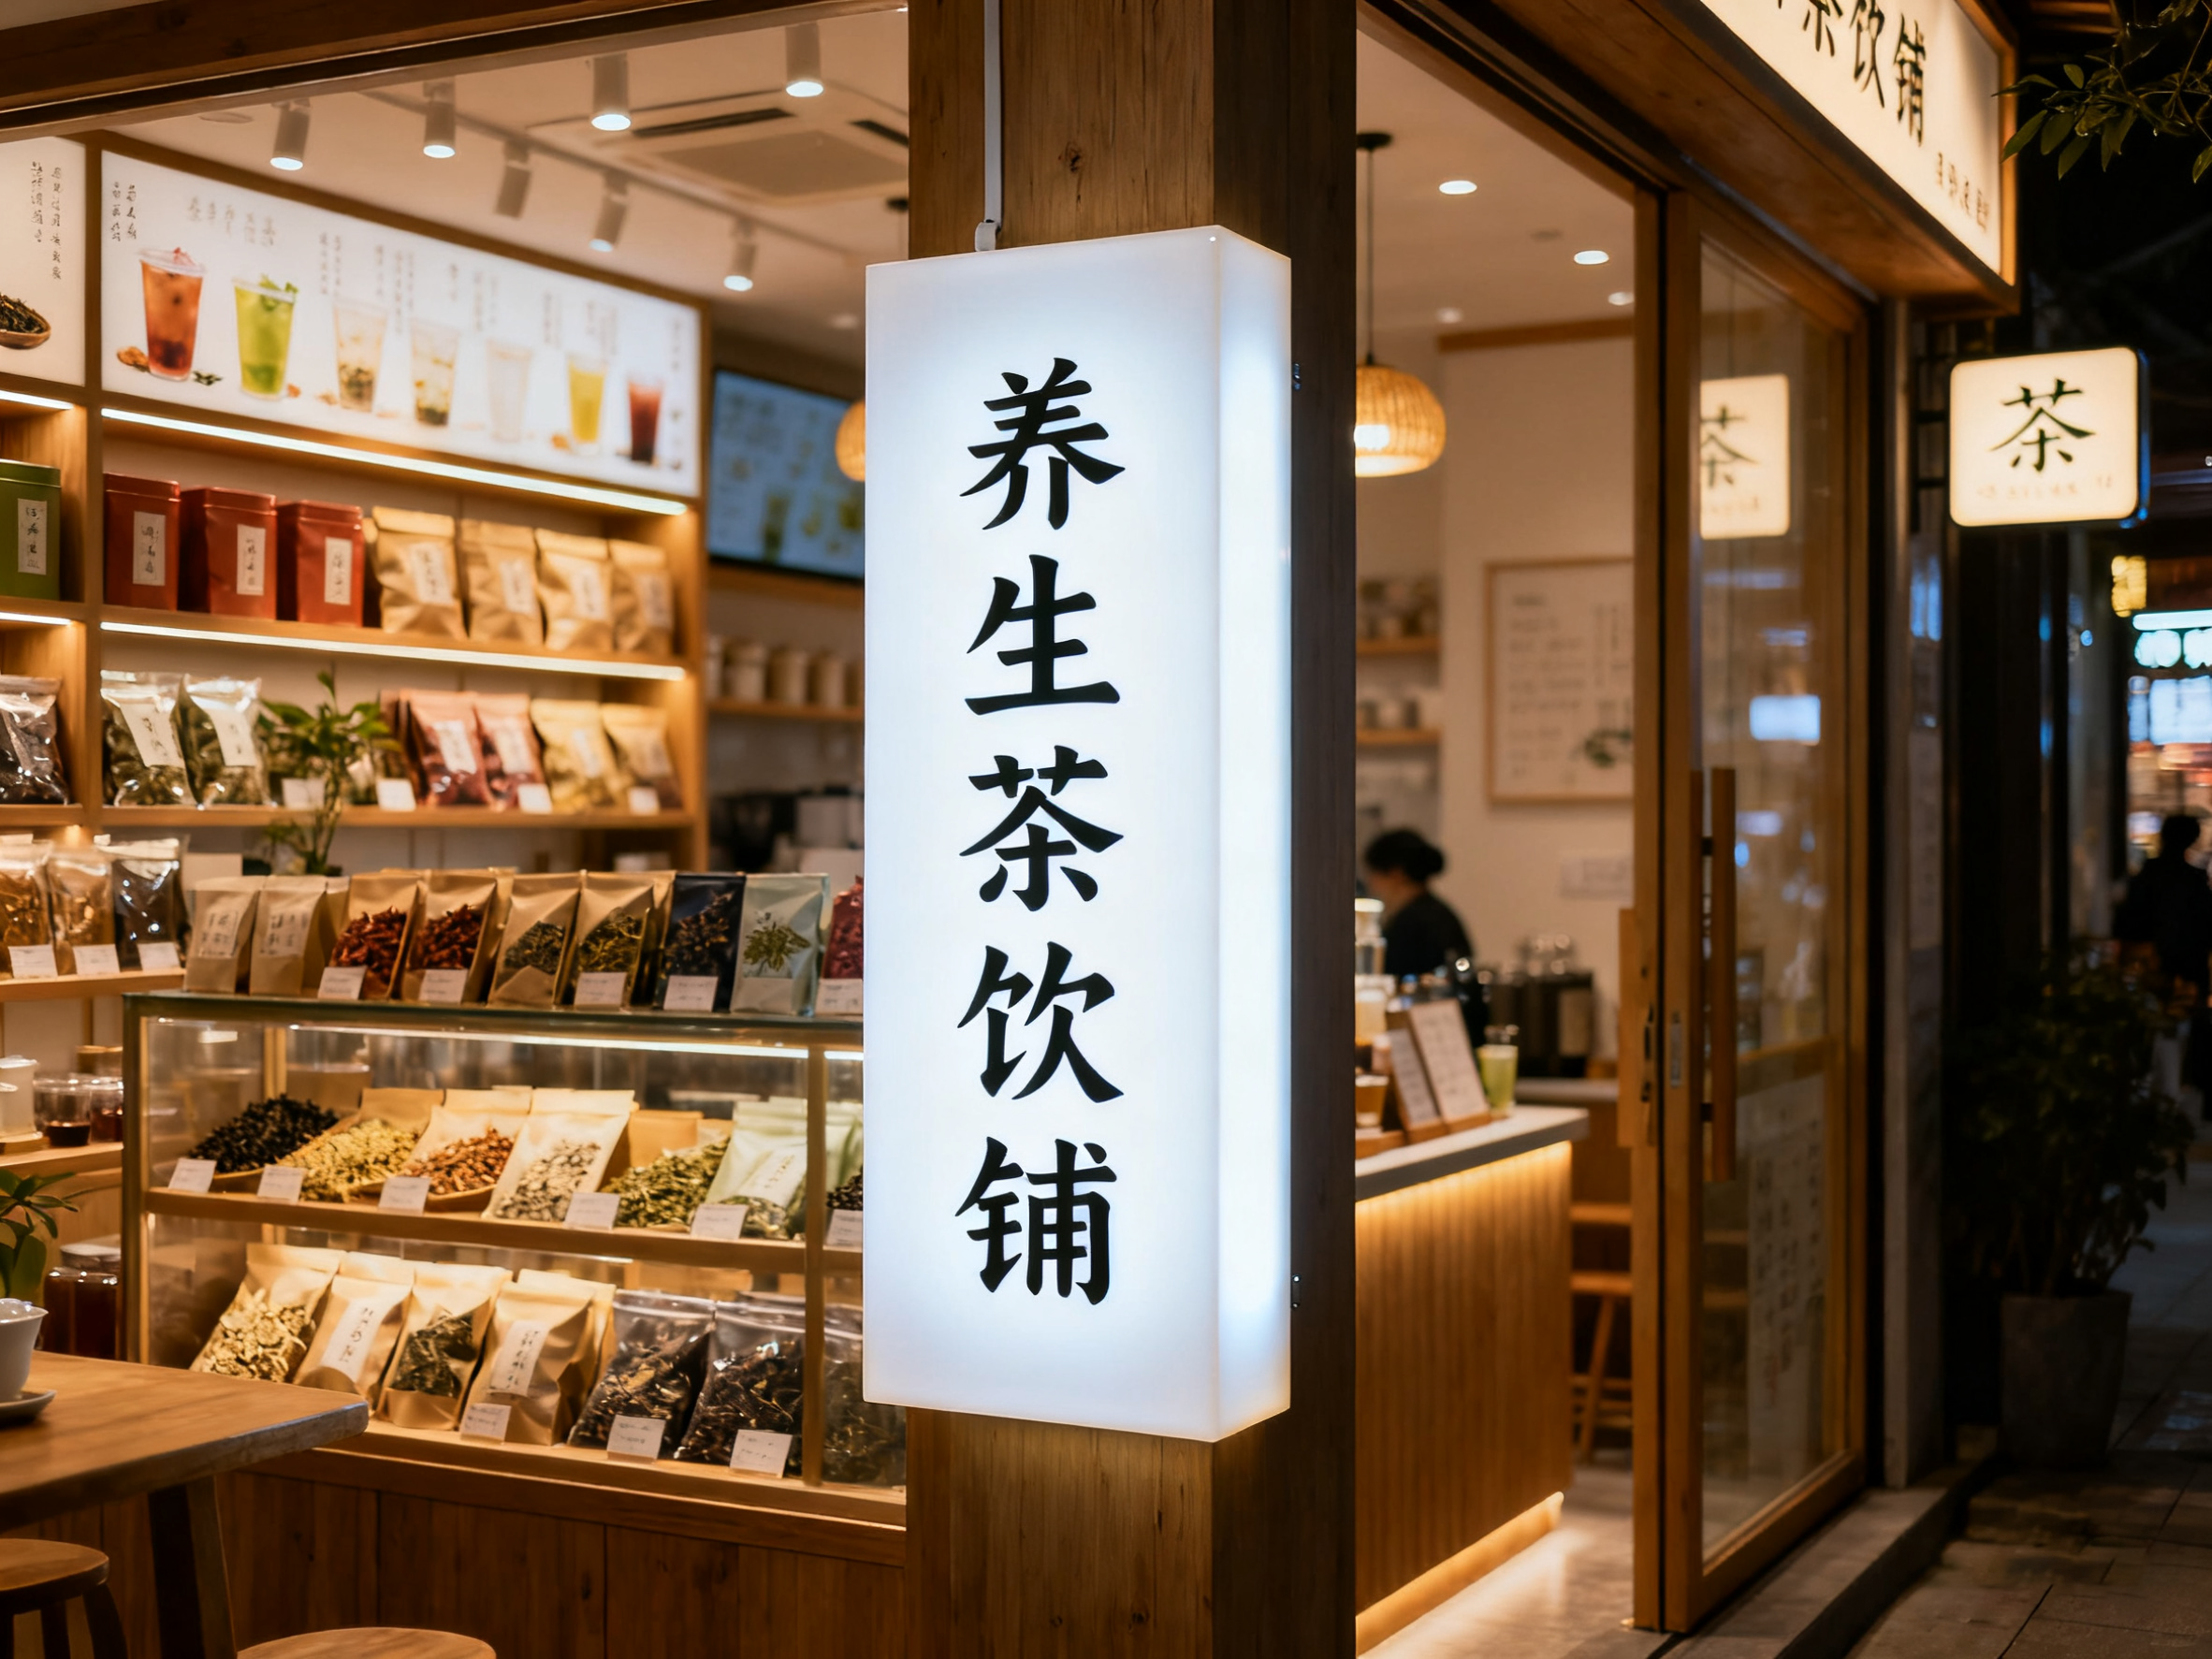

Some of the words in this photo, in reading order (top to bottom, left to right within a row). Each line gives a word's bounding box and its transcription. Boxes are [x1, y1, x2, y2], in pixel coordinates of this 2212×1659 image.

[1987, 378, 2097, 473] 茶
[954, 357, 1126, 1305] 养生茶饮铺
